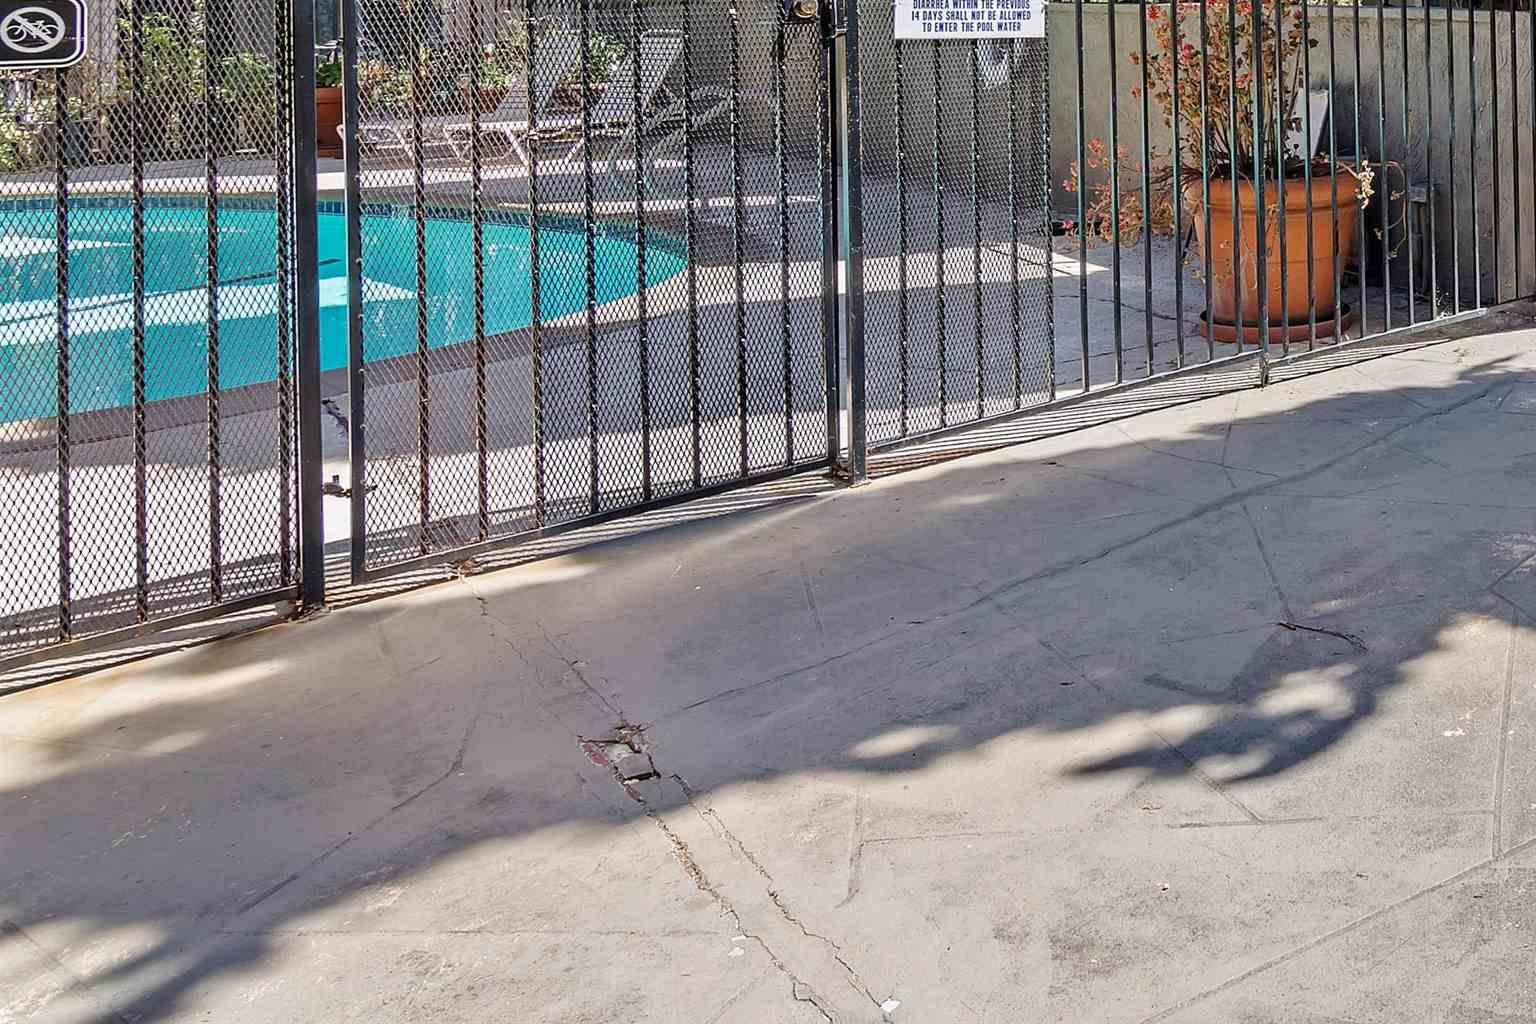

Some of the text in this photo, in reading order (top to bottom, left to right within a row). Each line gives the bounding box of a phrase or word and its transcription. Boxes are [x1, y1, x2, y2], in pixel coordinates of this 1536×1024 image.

[913, 0, 1030, 9] DIARRHEA WITHIN THE PREVIOUS
[911, 11, 1031, 21] 14 DAYS SHALL NOT BE ALLOWED
[922, 22, 1021, 32] TO ENTER THE POOL WATER
